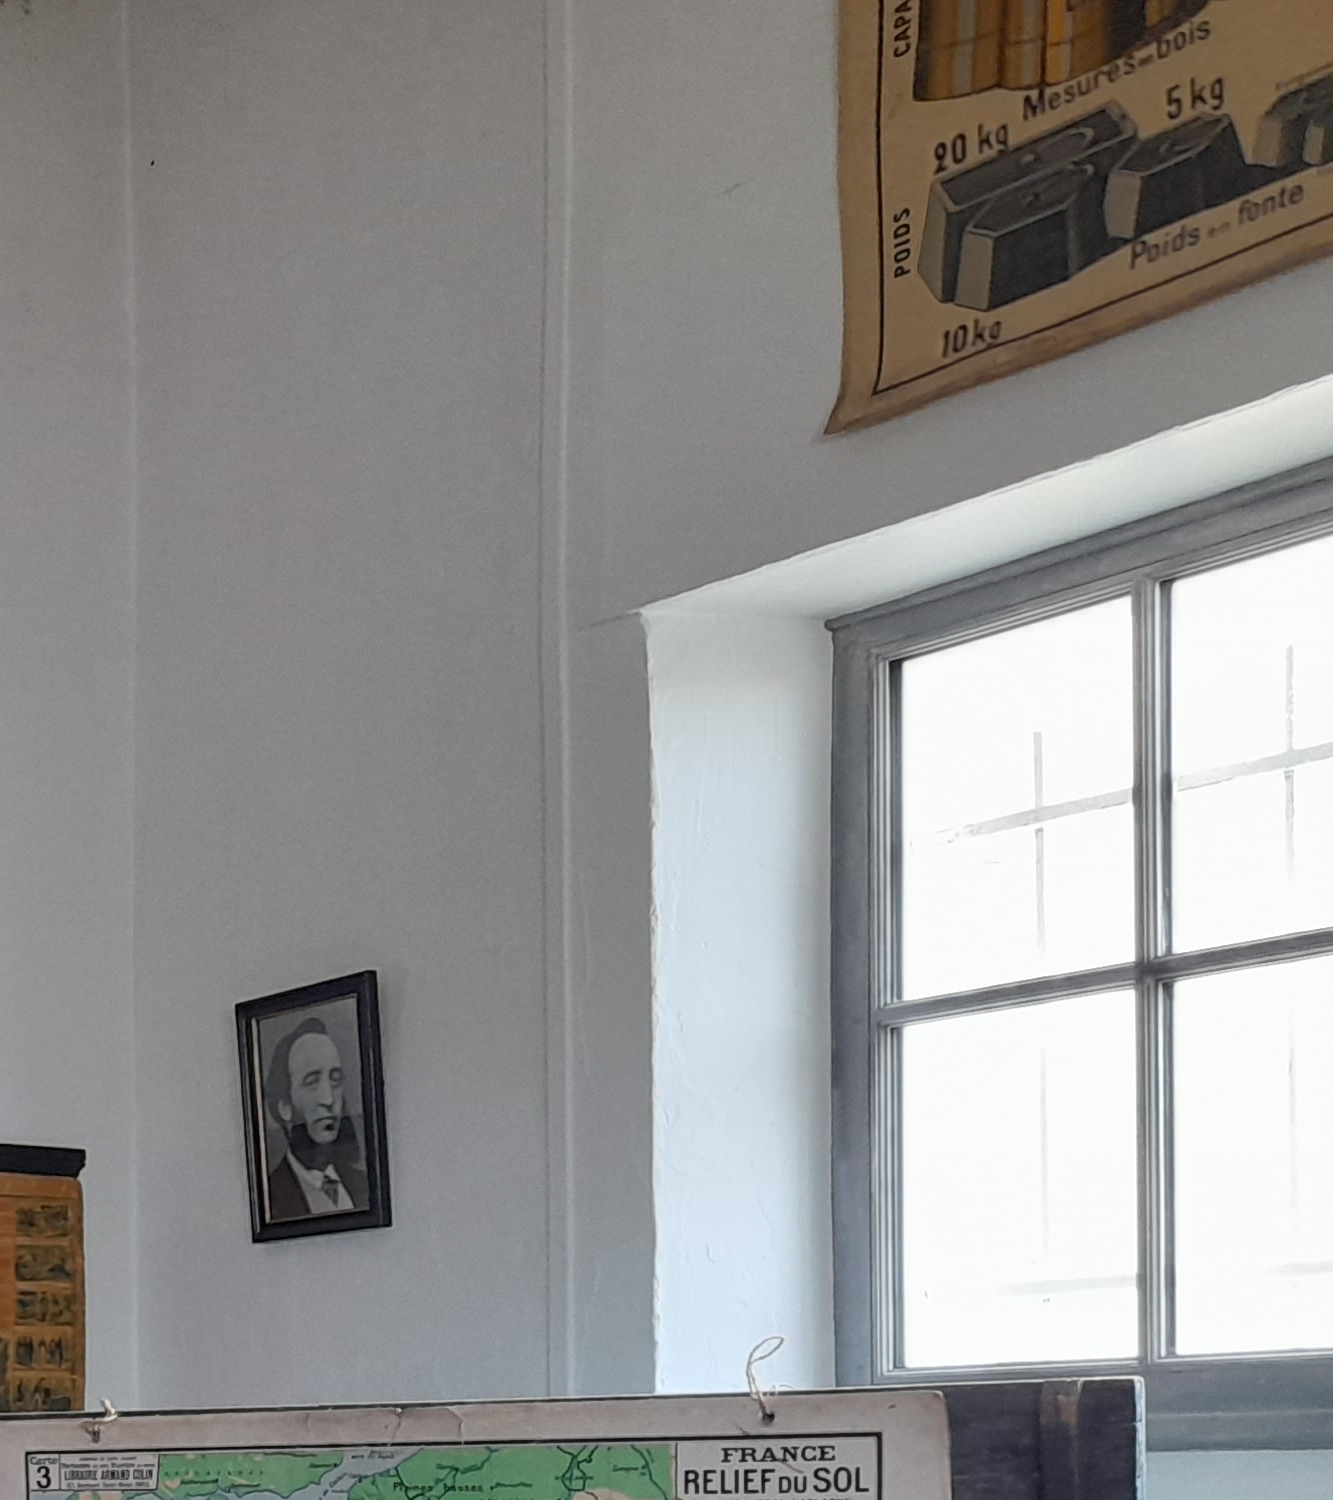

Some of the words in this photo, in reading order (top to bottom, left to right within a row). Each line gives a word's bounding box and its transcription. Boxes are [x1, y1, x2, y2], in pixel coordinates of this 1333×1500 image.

[1023, 54, 1137, 121] Mesures
[1166, 85, 1183, 119] 5
[1191, 77, 1225, 111] kg
[935, 133, 967, 174] 20
[893, 207, 912, 279] POIDS
[1129, 224, 1201, 270] Poids
[1237, 184, 1305, 226] fonte
[942, 324, 968, 358] 10
[720, 1445, 837, 1464] FRANCE
[36, 1465, 52, 1489] 3
[684, 1468, 776, 1495] RELIEF
[778, 1475, 807, 1494] DU
[813, 1466, 870, 1493] SOL
